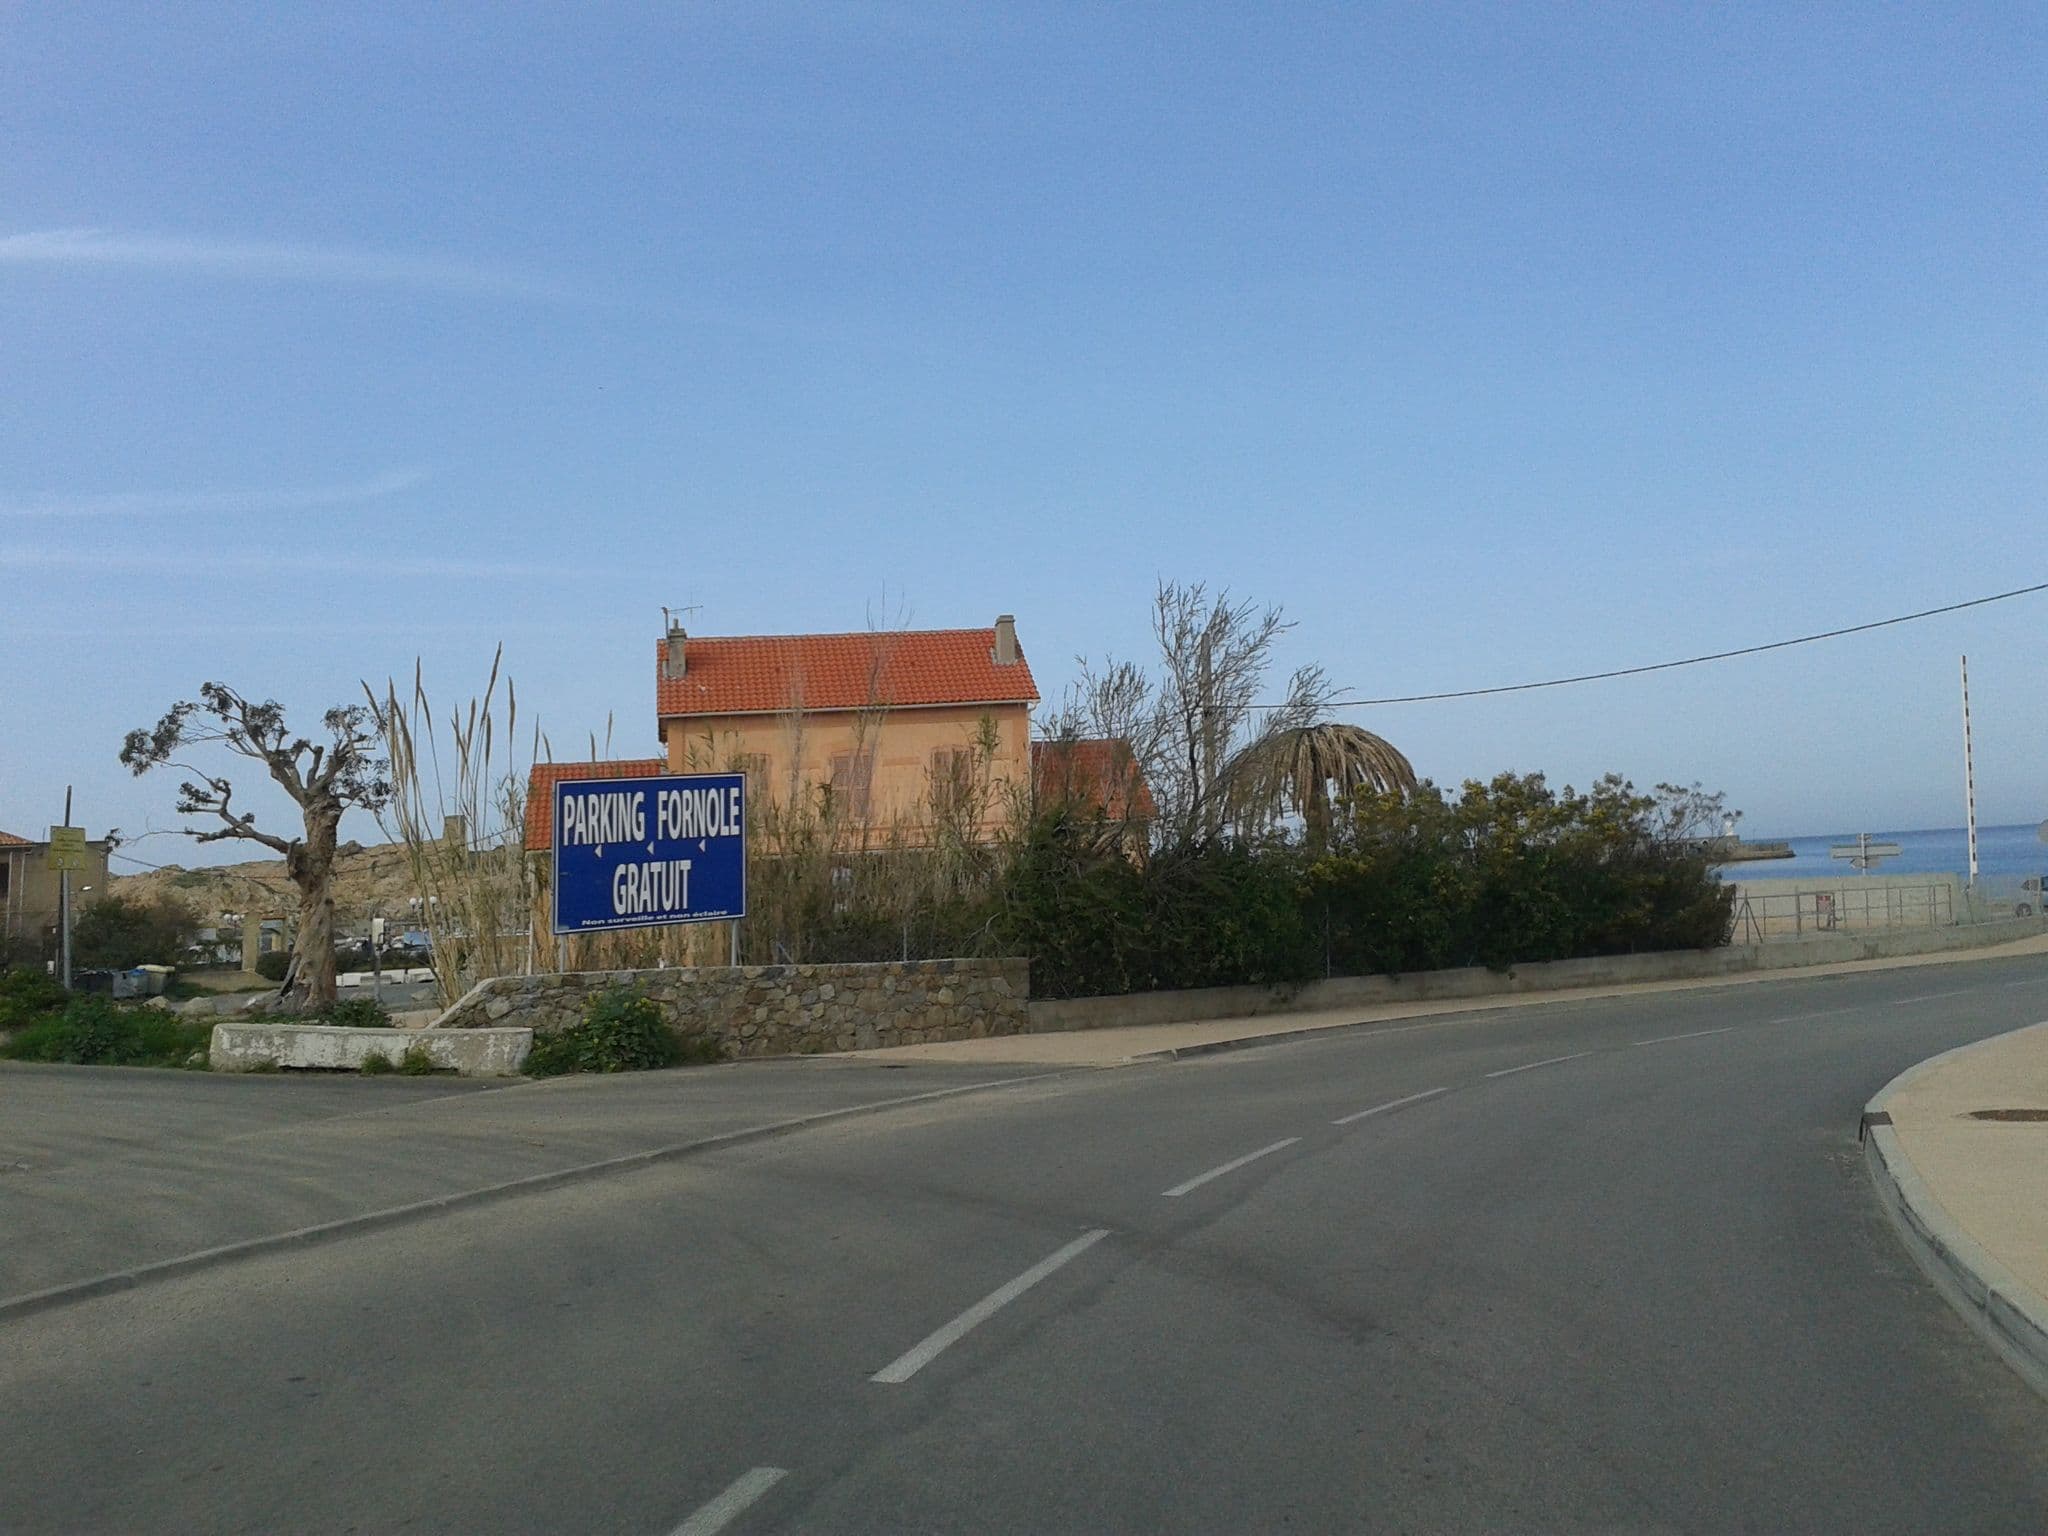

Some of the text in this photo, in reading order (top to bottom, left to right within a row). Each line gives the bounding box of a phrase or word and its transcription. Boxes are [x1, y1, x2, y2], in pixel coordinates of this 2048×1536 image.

[564, 788, 739, 845] PARKING FORNOLE
[613, 860, 691, 915] GRATUIT
